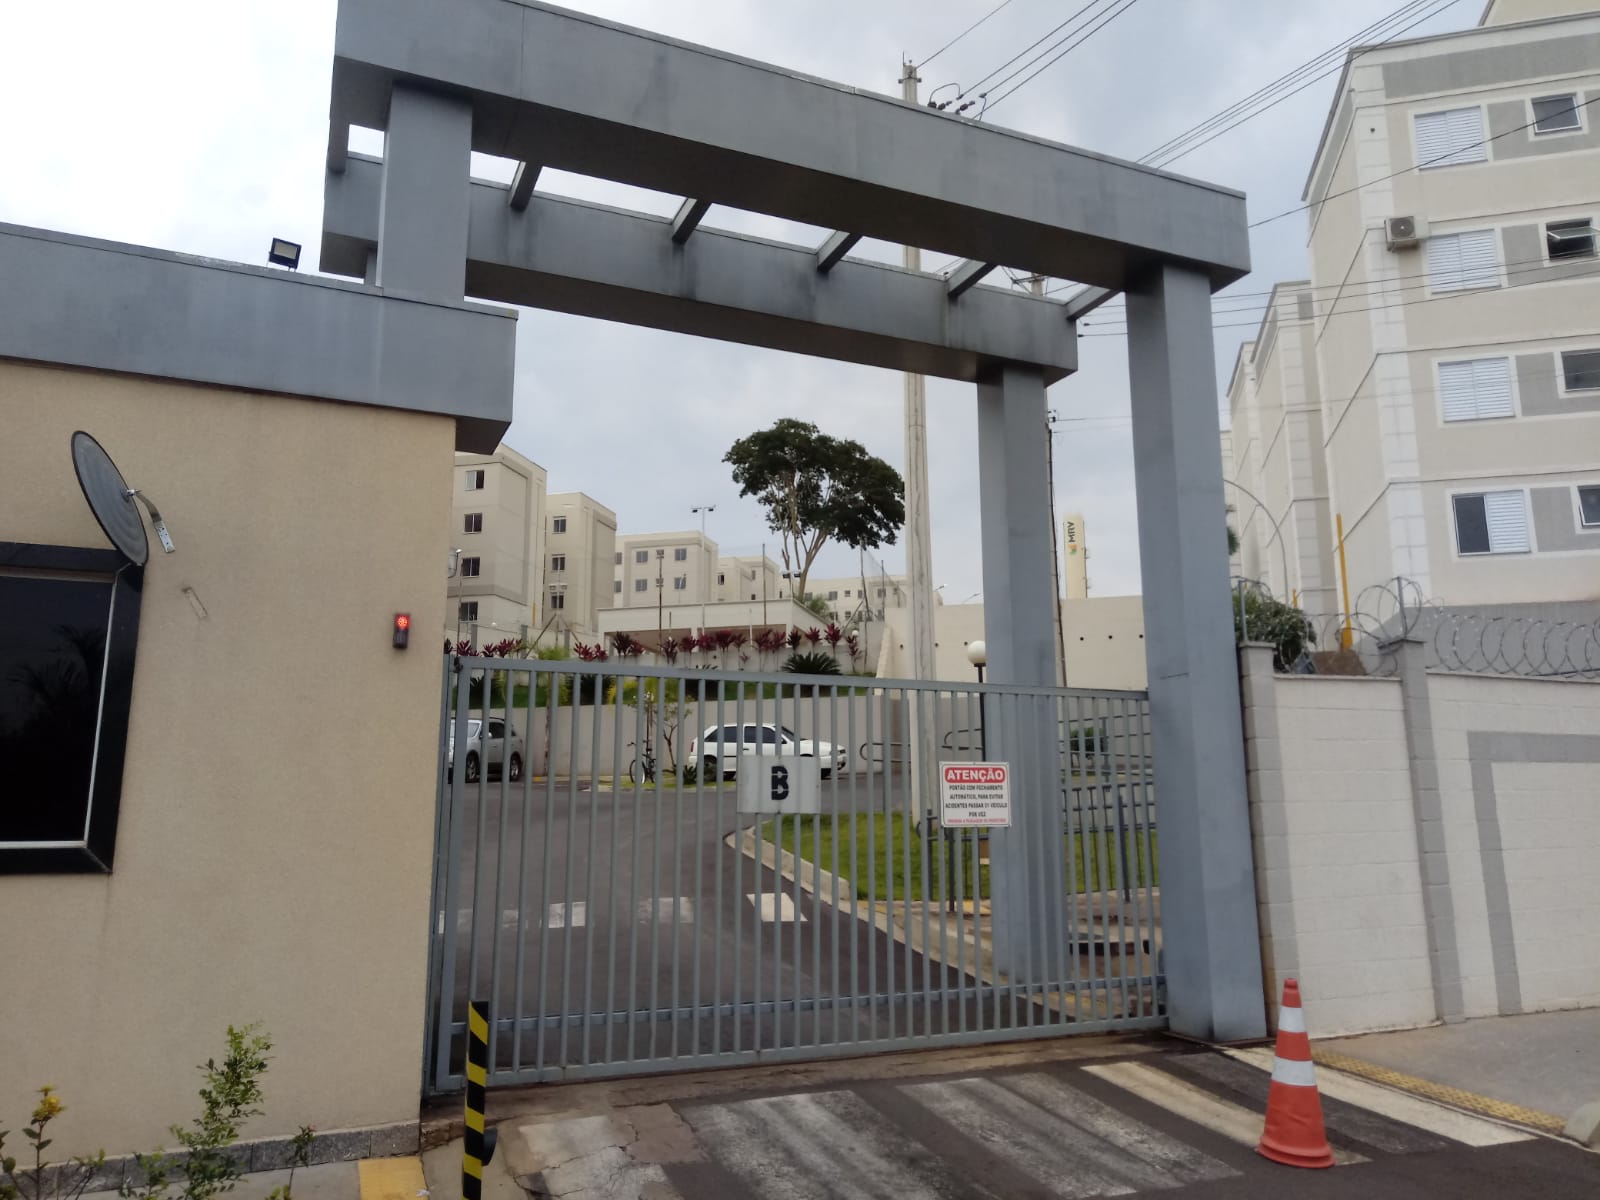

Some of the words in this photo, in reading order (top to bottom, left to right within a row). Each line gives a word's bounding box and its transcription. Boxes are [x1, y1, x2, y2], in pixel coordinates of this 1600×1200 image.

[1067, 521, 1076, 543] MRV
[771, 765, 790, 801] B
[947, 768, 1004, 783] ATENÇÃO
